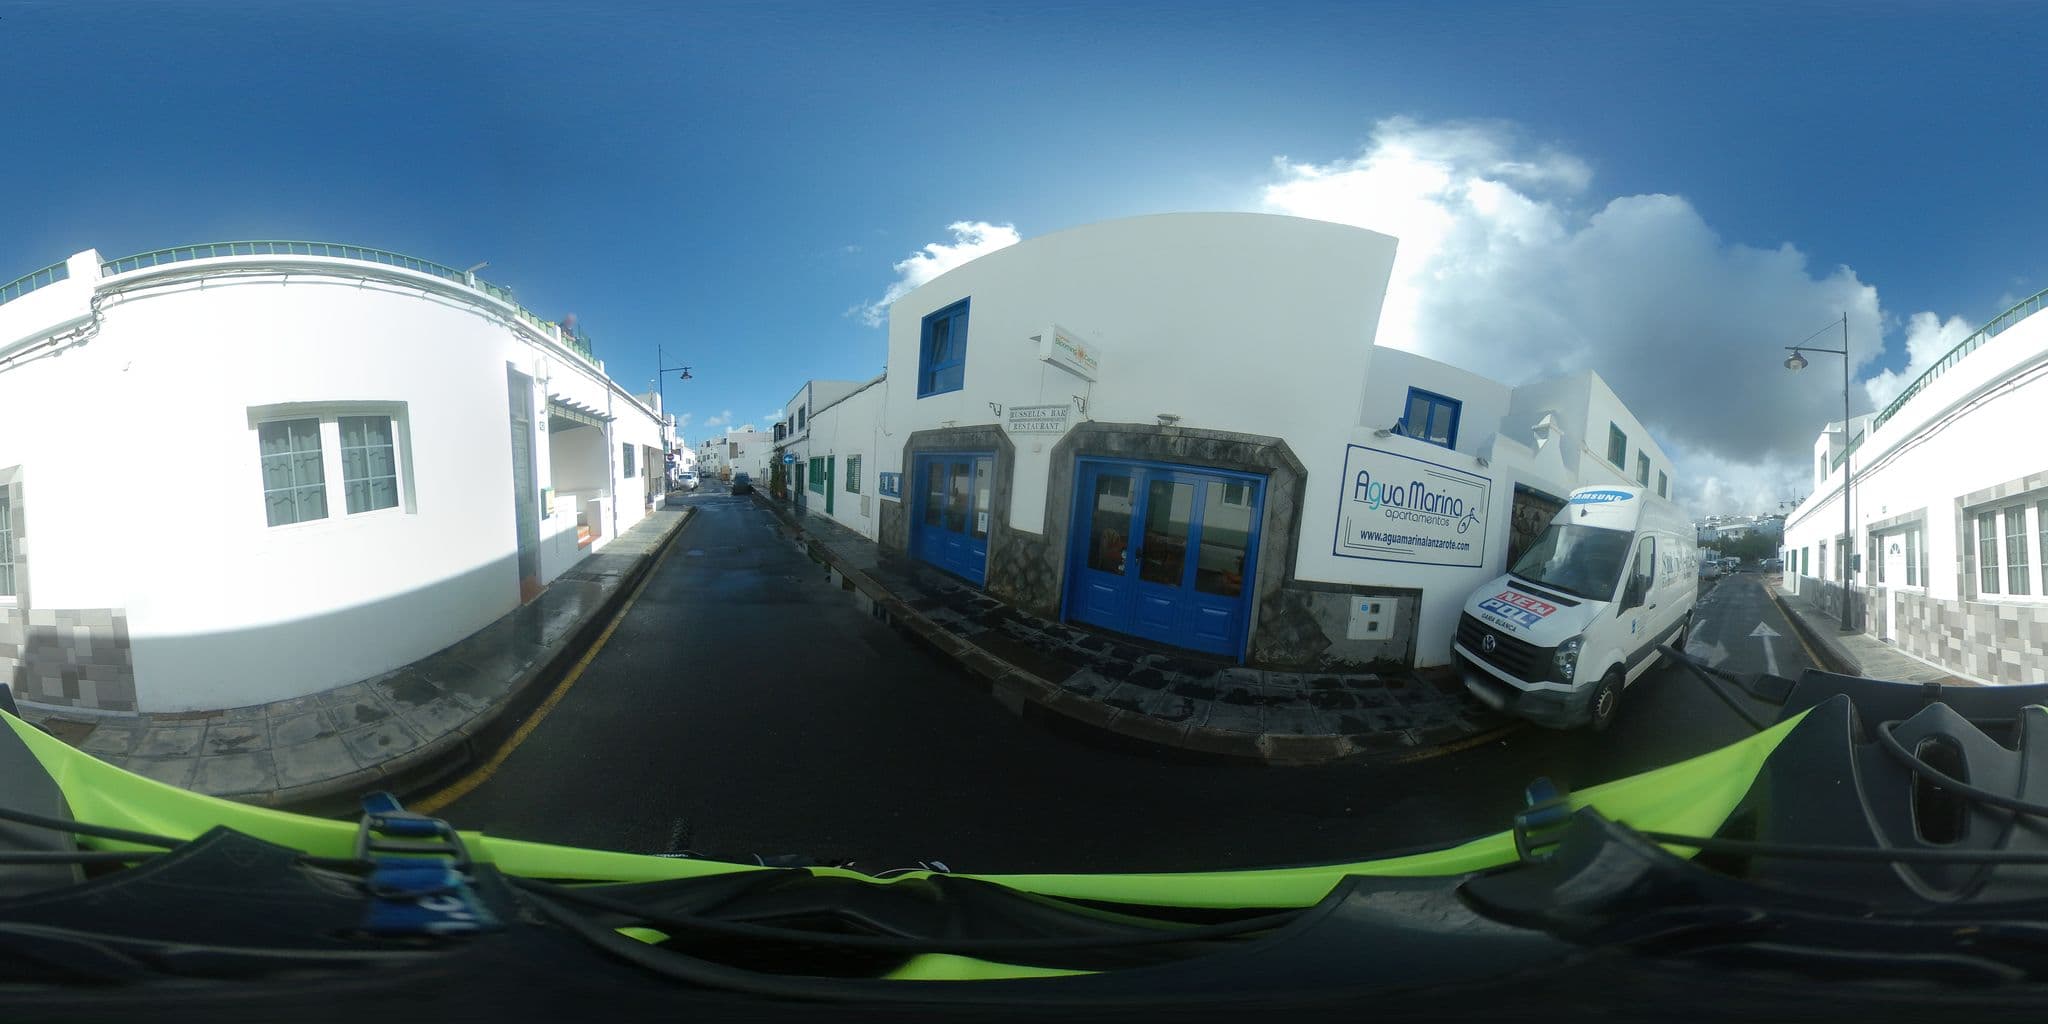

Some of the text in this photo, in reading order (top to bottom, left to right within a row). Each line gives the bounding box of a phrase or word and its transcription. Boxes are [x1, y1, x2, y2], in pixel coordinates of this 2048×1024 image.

[1051, 408, 1067, 417] BAR
[1013, 422, 1060, 430] RESTAURANT
[1354, 470, 1463, 517] Agua Marina
[1570, 493, 1623, 502] SAMSUNG
[1385, 508, 1450, 526] apartamentos
[1360, 529, 1470, 551] www.aguamarinalanzarote.com
[1498, 592, 1553, 615] NEW
